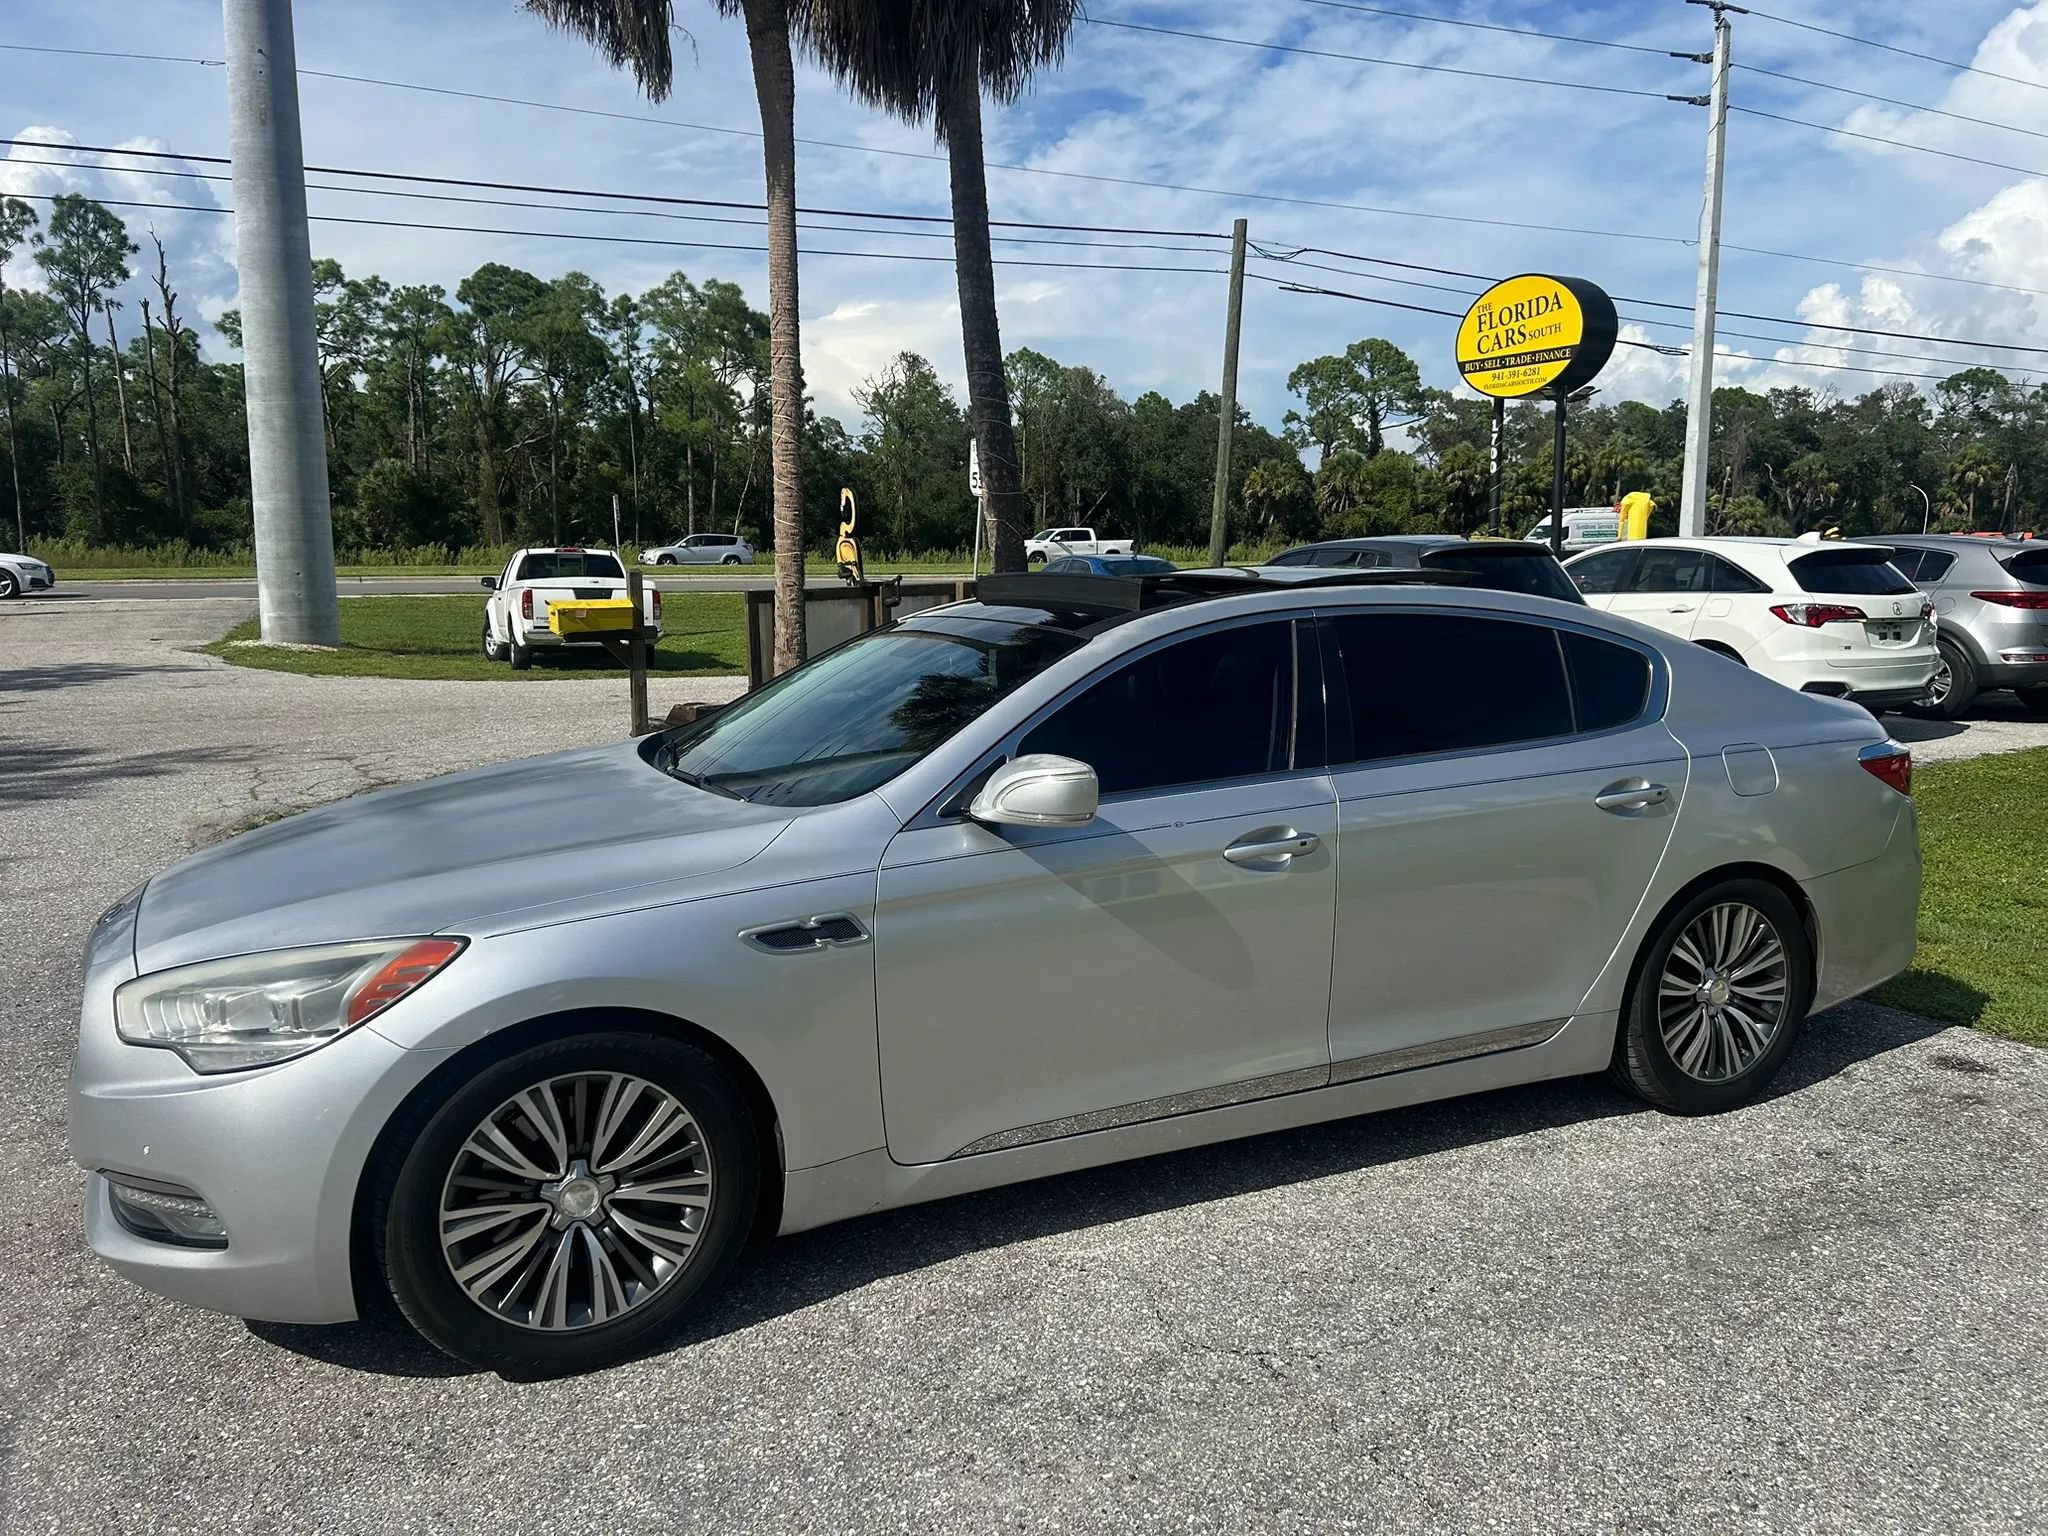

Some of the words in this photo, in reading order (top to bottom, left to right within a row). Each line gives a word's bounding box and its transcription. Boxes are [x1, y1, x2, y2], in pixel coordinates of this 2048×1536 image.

[1477, 302, 1492, 314] THE
[1477, 291, 1563, 333] FLORIDA
[1477, 324, 1527, 355] CARS
[1528, 322, 1562, 341] SOUTH
[1491, 367, 1540, 381] 941-391-6281
